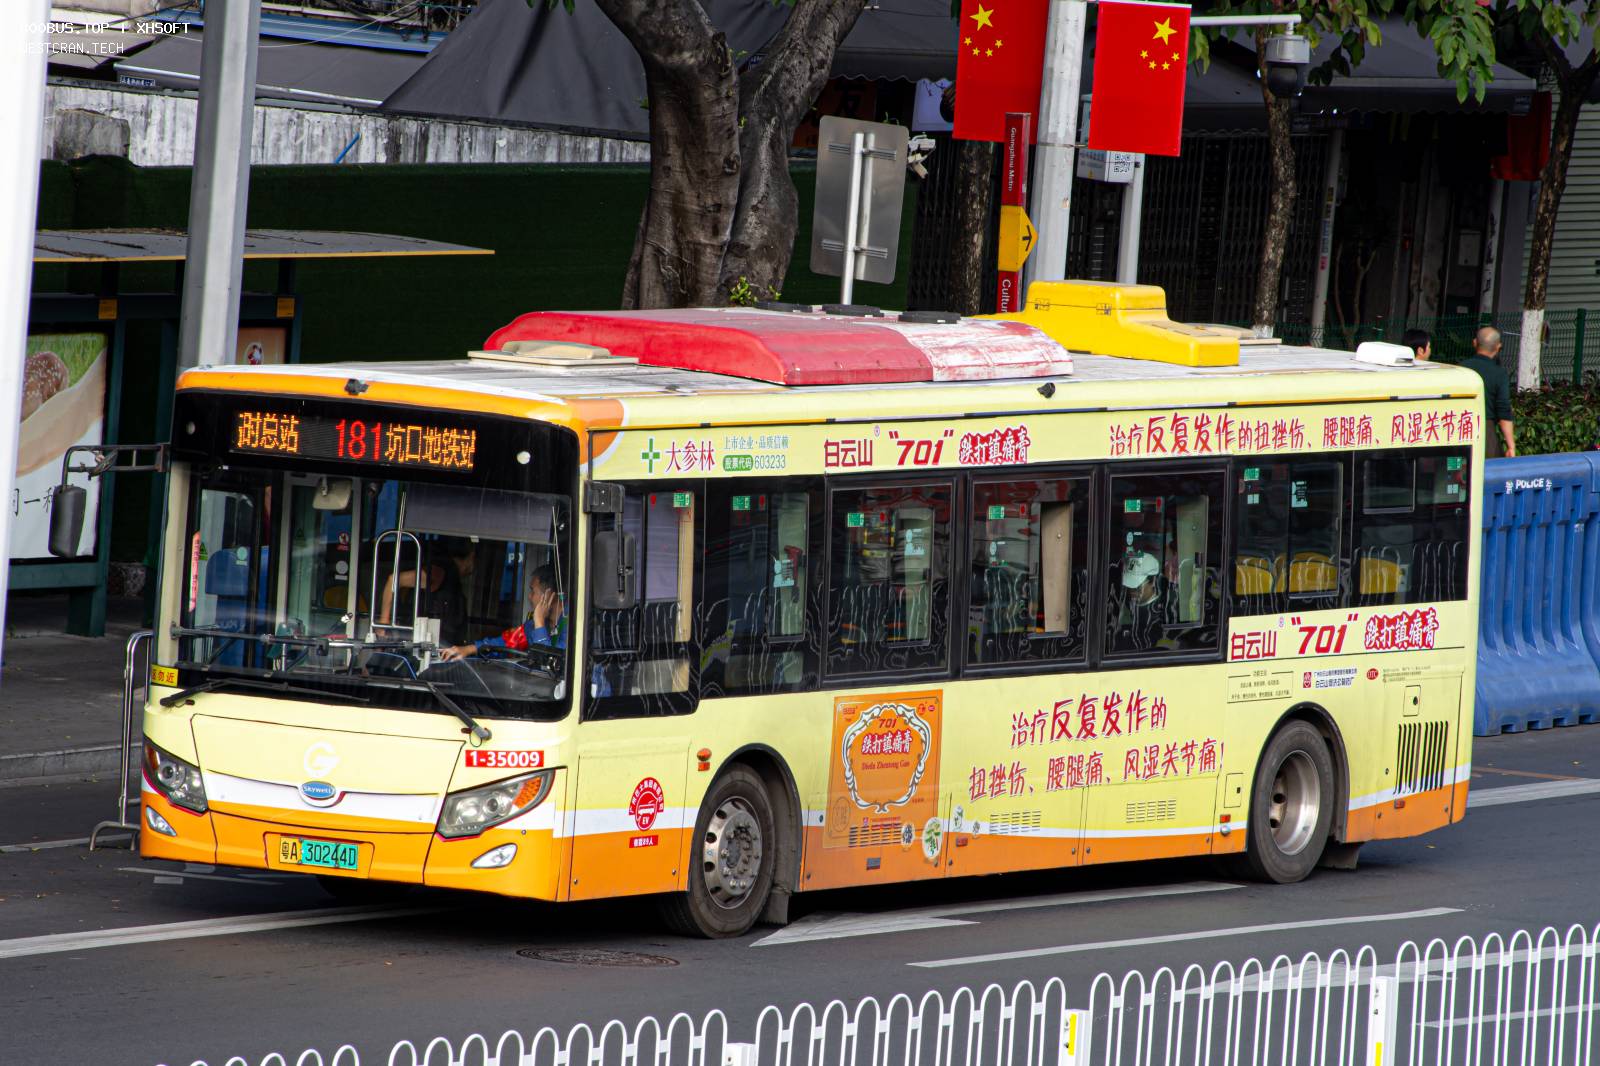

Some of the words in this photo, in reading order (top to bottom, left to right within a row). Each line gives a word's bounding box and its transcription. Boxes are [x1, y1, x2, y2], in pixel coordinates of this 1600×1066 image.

[1008, 127, 1017, 168] Guangzhou
[335, 418, 383, 461] 181
[824, 439, 873, 468] 白云山
[665, 440, 716, 473] 大参林
[754, 454, 786, 470] 603233
[1515, 478, 1545, 490] POLICE
[1230, 630, 1277, 661] 白云山
[1010, 689, 1168, 749] 治疗反复发作的
[470, 750, 540, 767] 1-35009
